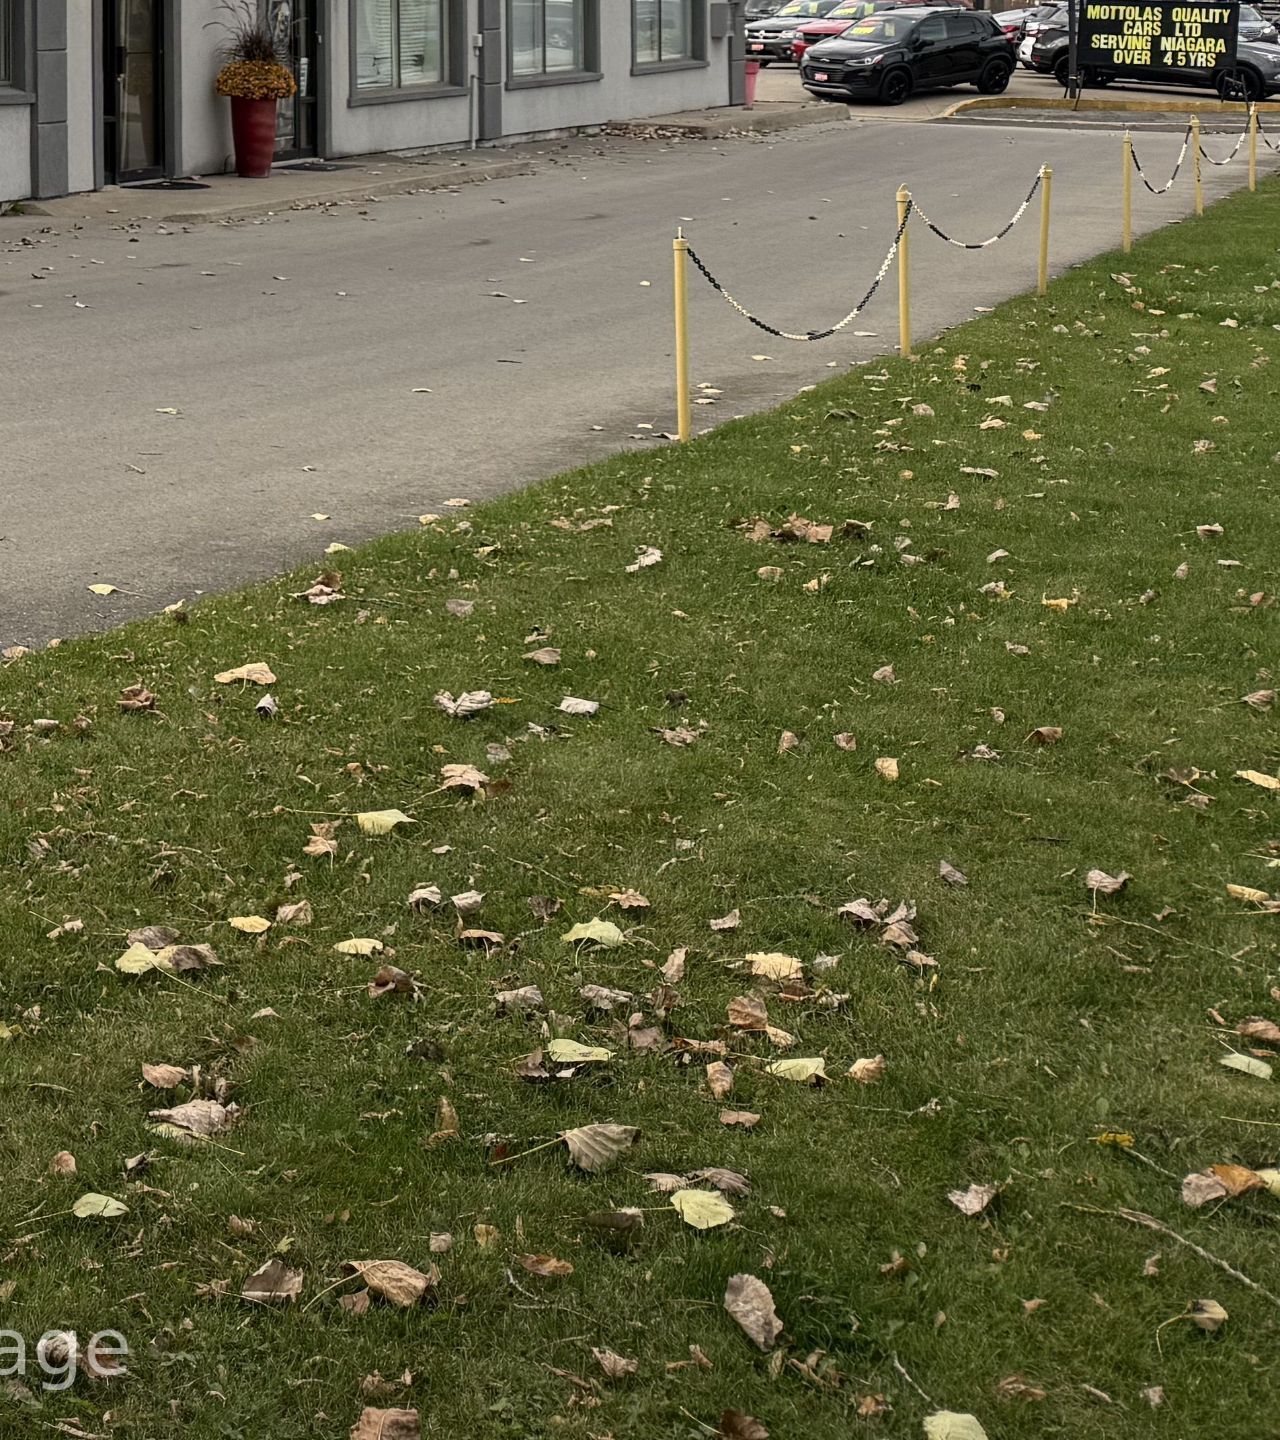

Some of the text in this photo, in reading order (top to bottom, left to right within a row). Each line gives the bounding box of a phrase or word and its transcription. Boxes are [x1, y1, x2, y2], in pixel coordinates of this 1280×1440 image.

[1087, 5, 1231, 24] MOTTOLAS QUALITY
[1123, 21, 1202, 37] CARS LTD
[1091, 34, 1226, 54] SERVING NIAGARA
[1113, 49, 1151, 65] OVER
